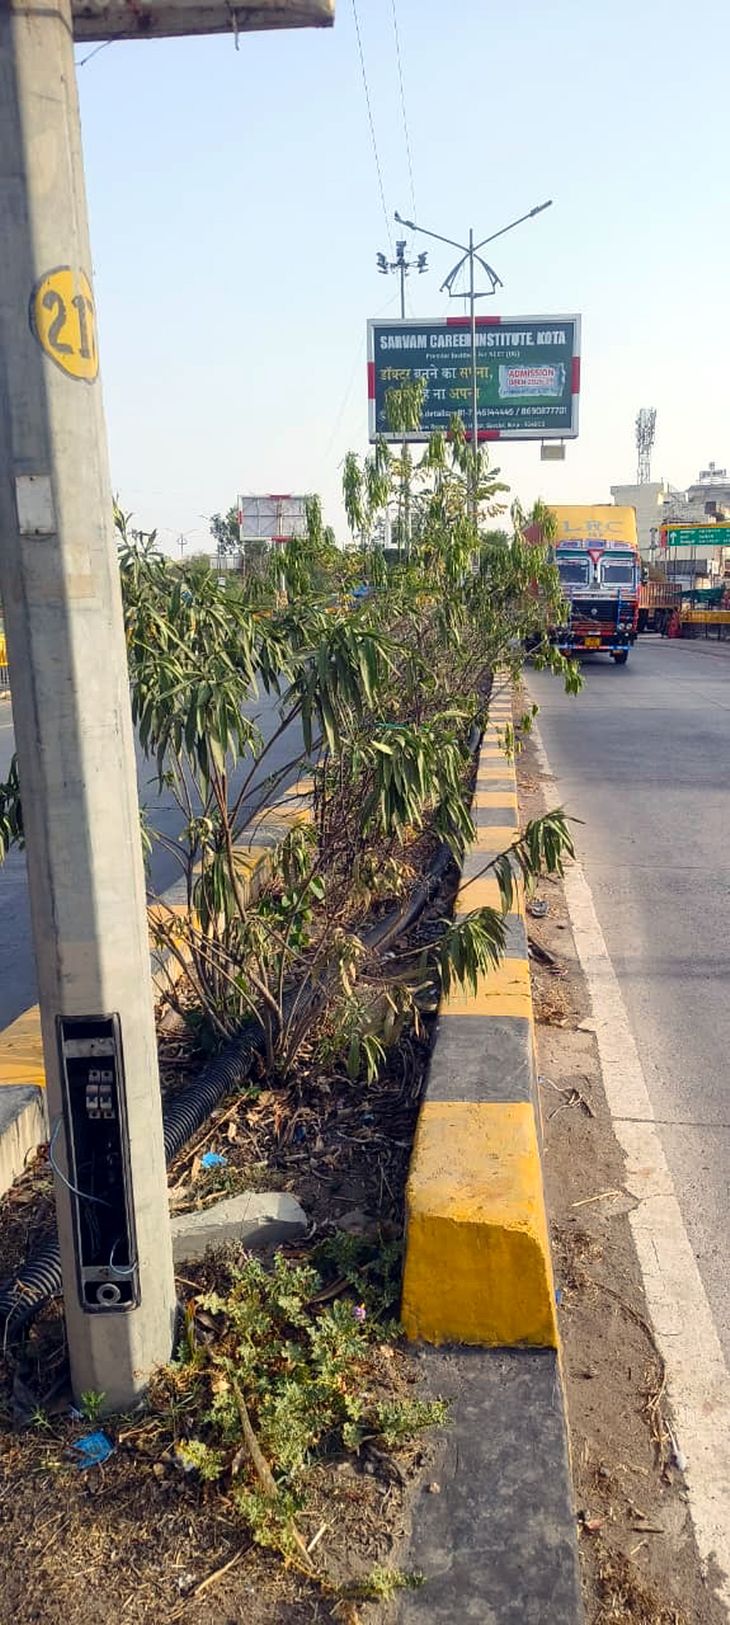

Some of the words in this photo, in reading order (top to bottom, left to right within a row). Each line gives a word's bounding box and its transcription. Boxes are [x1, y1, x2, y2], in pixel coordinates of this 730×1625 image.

[380, 334, 427, 350] SARVAM
[537, 330, 566, 345] KOTA
[441, 368, 457, 379] का
